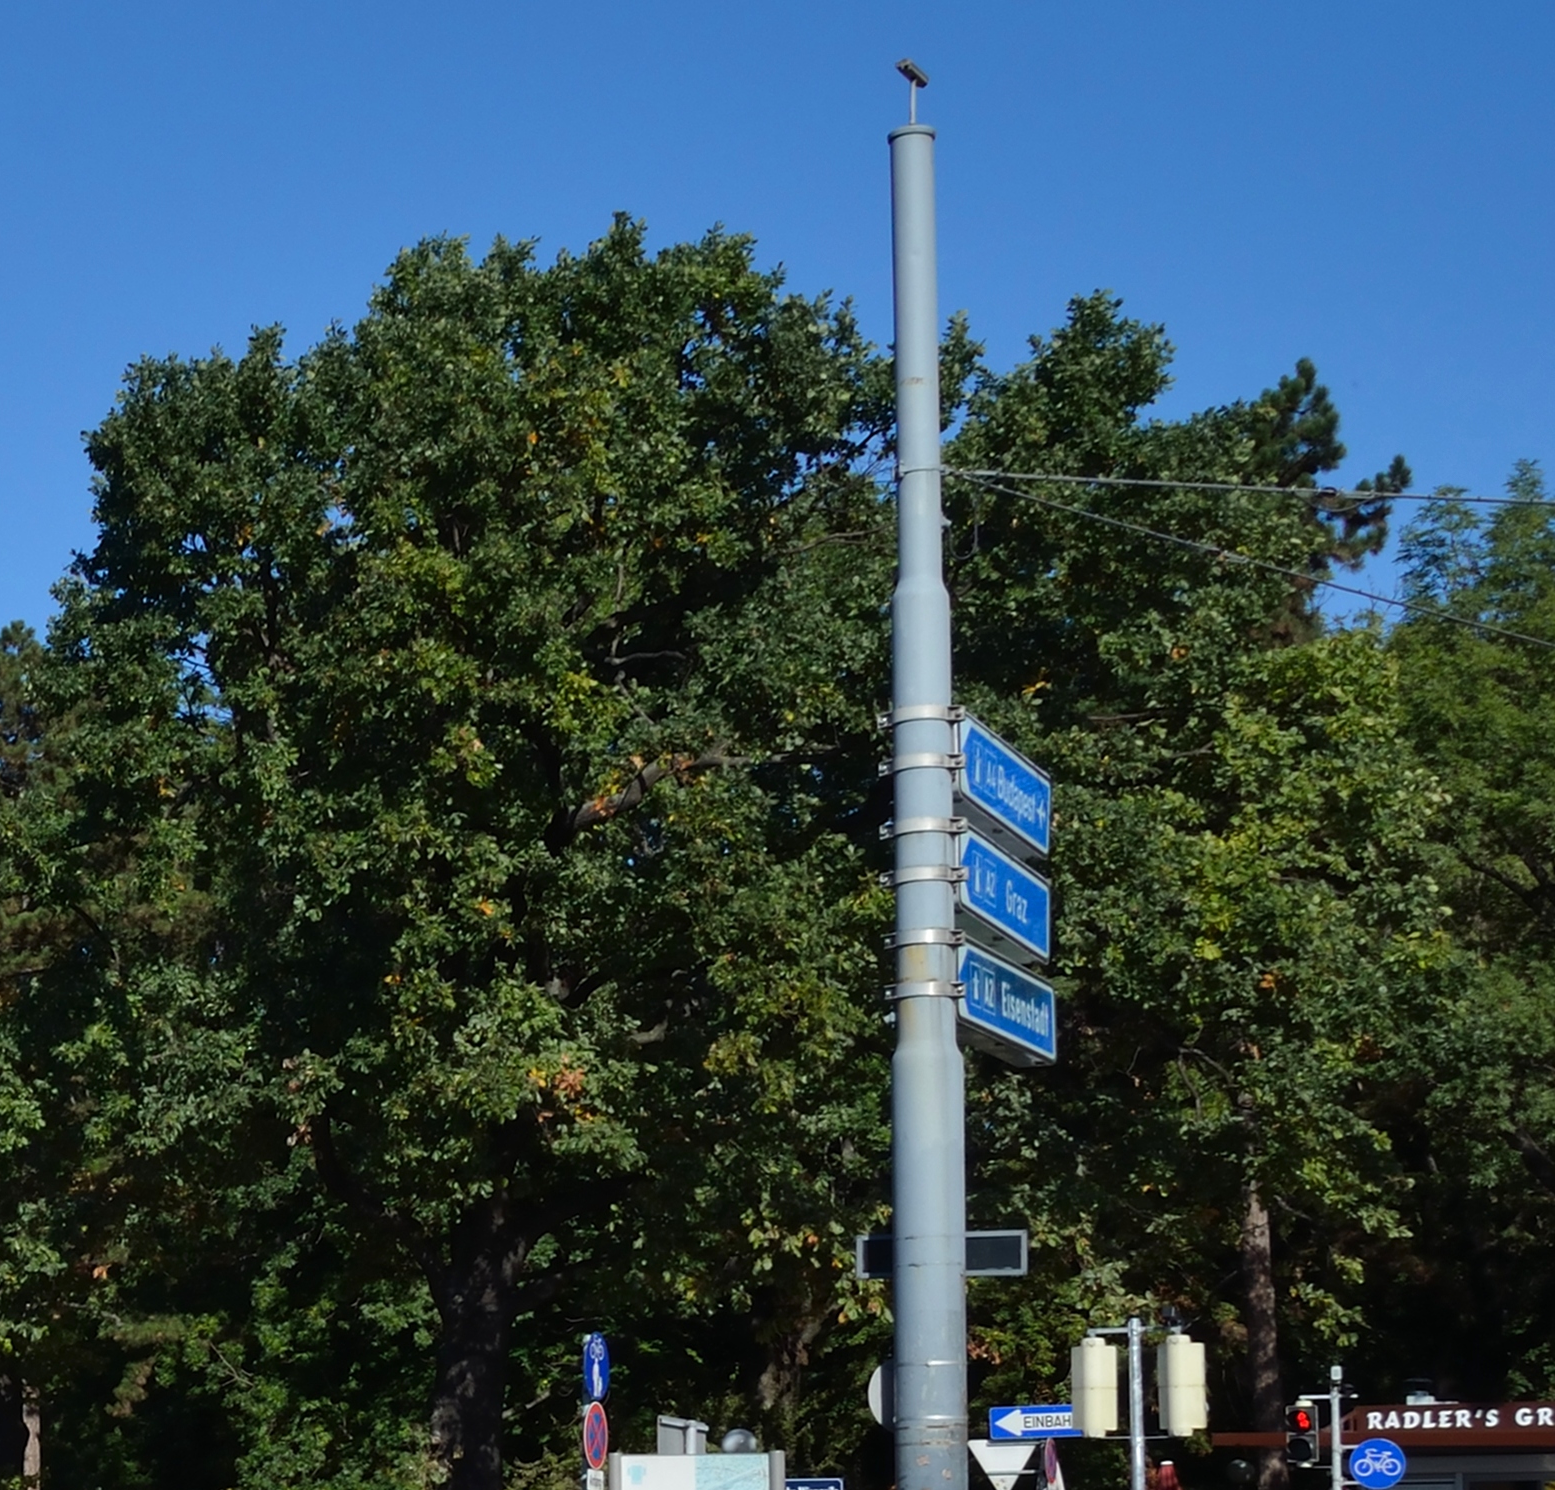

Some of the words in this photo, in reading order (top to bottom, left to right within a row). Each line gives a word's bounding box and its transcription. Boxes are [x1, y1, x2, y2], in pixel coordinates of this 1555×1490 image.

[998, 764, 1036, 824] Budapest
[1005, 879, 1028, 924] Graz
[1001, 980, 1049, 1038] Eisenstadt
[1023, 1415, 1071, 1428] EINBAH
[1366, 1408, 1500, 1430] RADLER'S
[1515, 1407, 1555, 1427] GR
